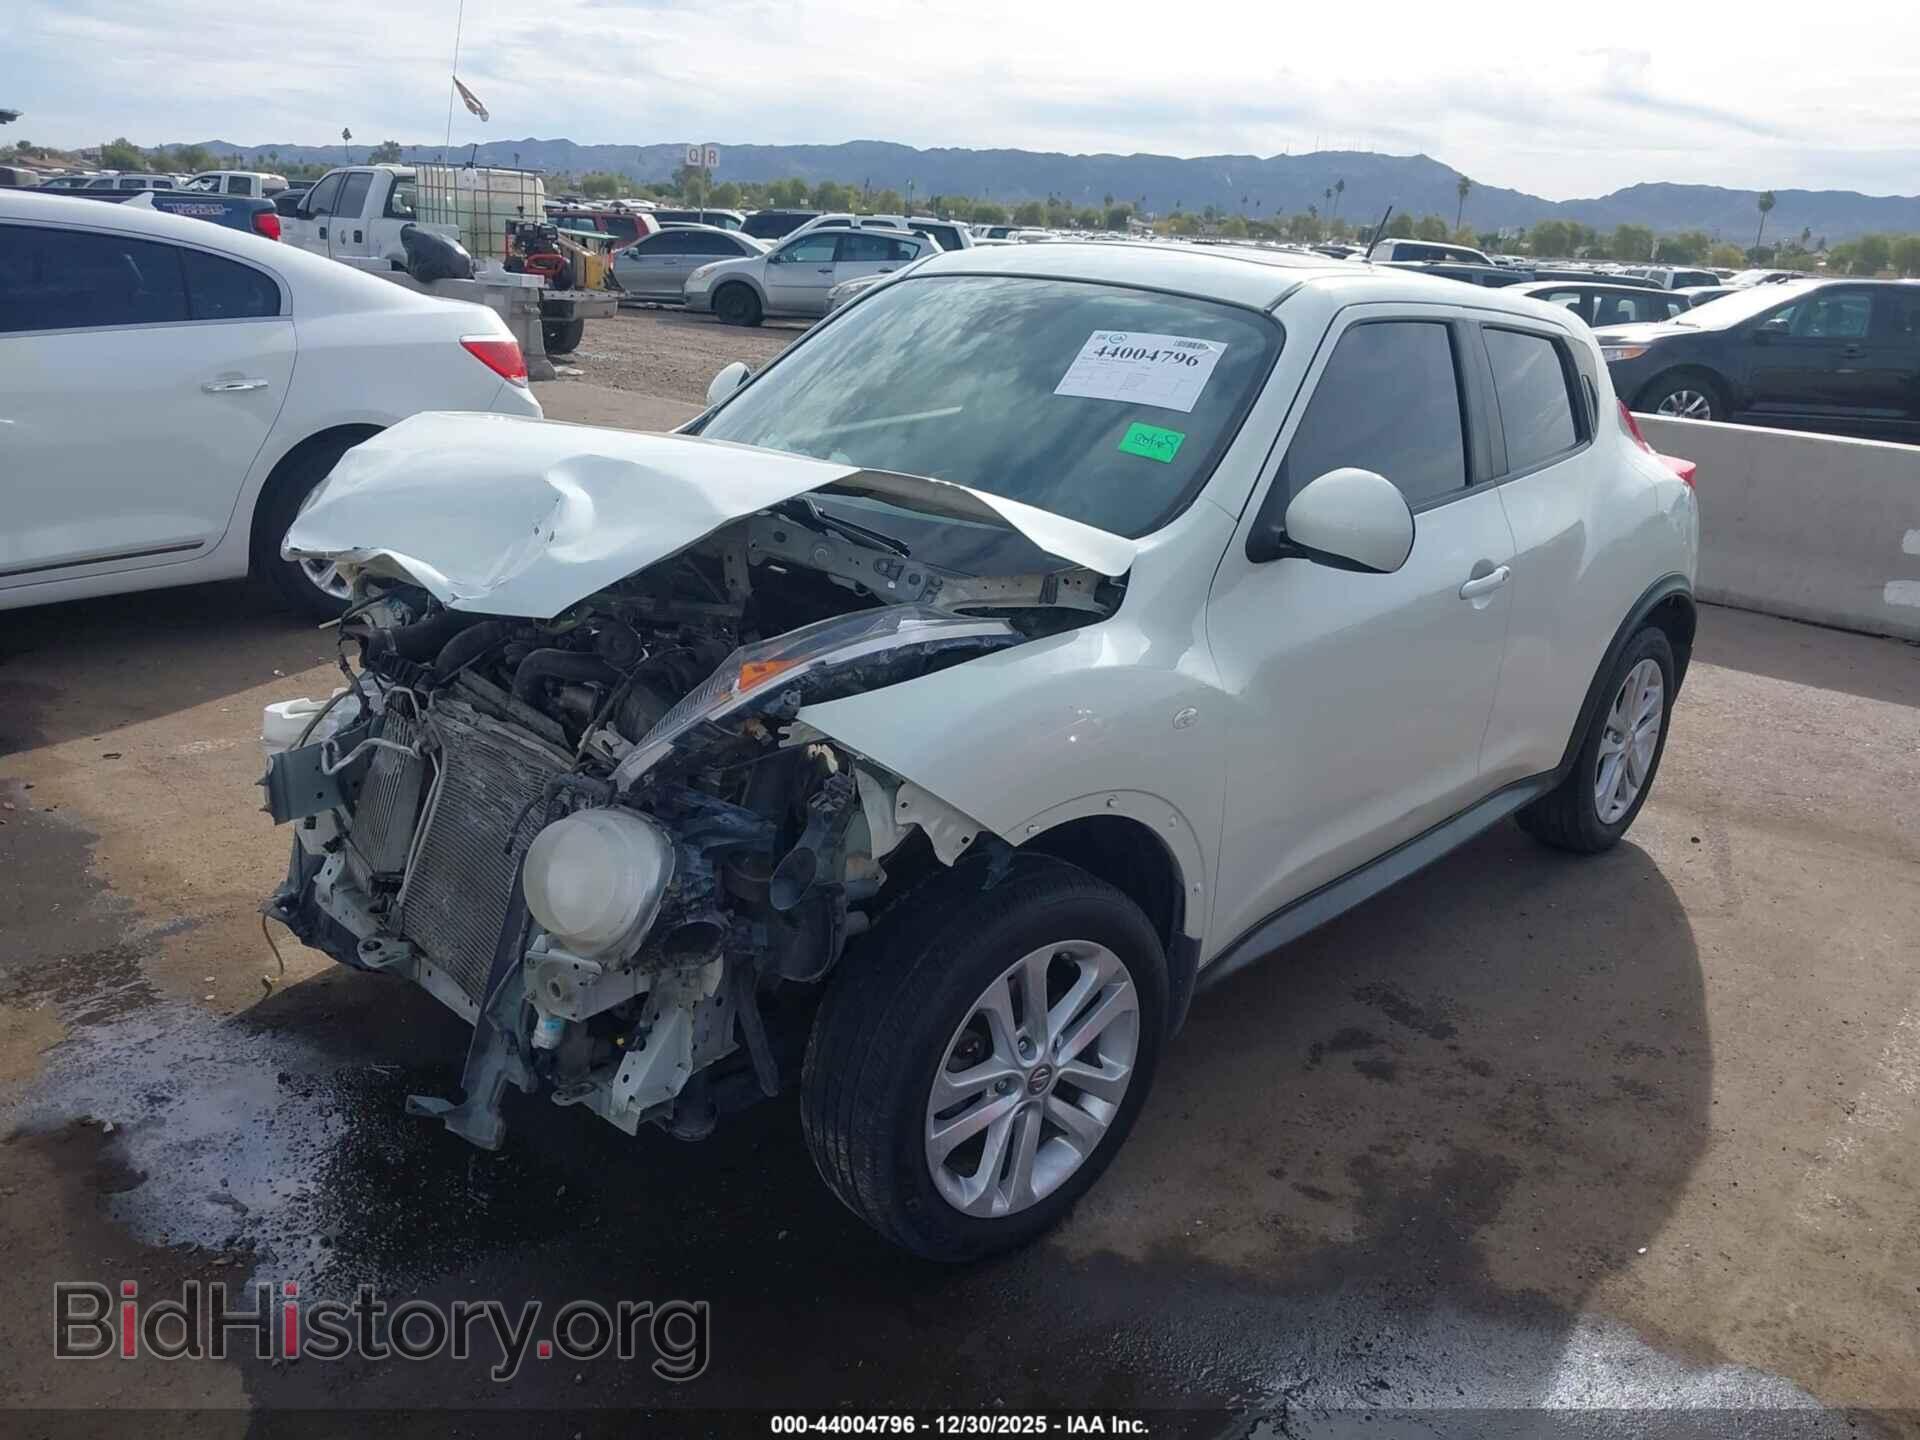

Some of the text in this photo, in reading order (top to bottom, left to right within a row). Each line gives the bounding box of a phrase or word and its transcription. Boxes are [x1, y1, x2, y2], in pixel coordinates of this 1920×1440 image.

[688, 148, 699, 163] Q
[708, 150, 717, 164] R
[1093, 345, 1200, 367] 44004796
